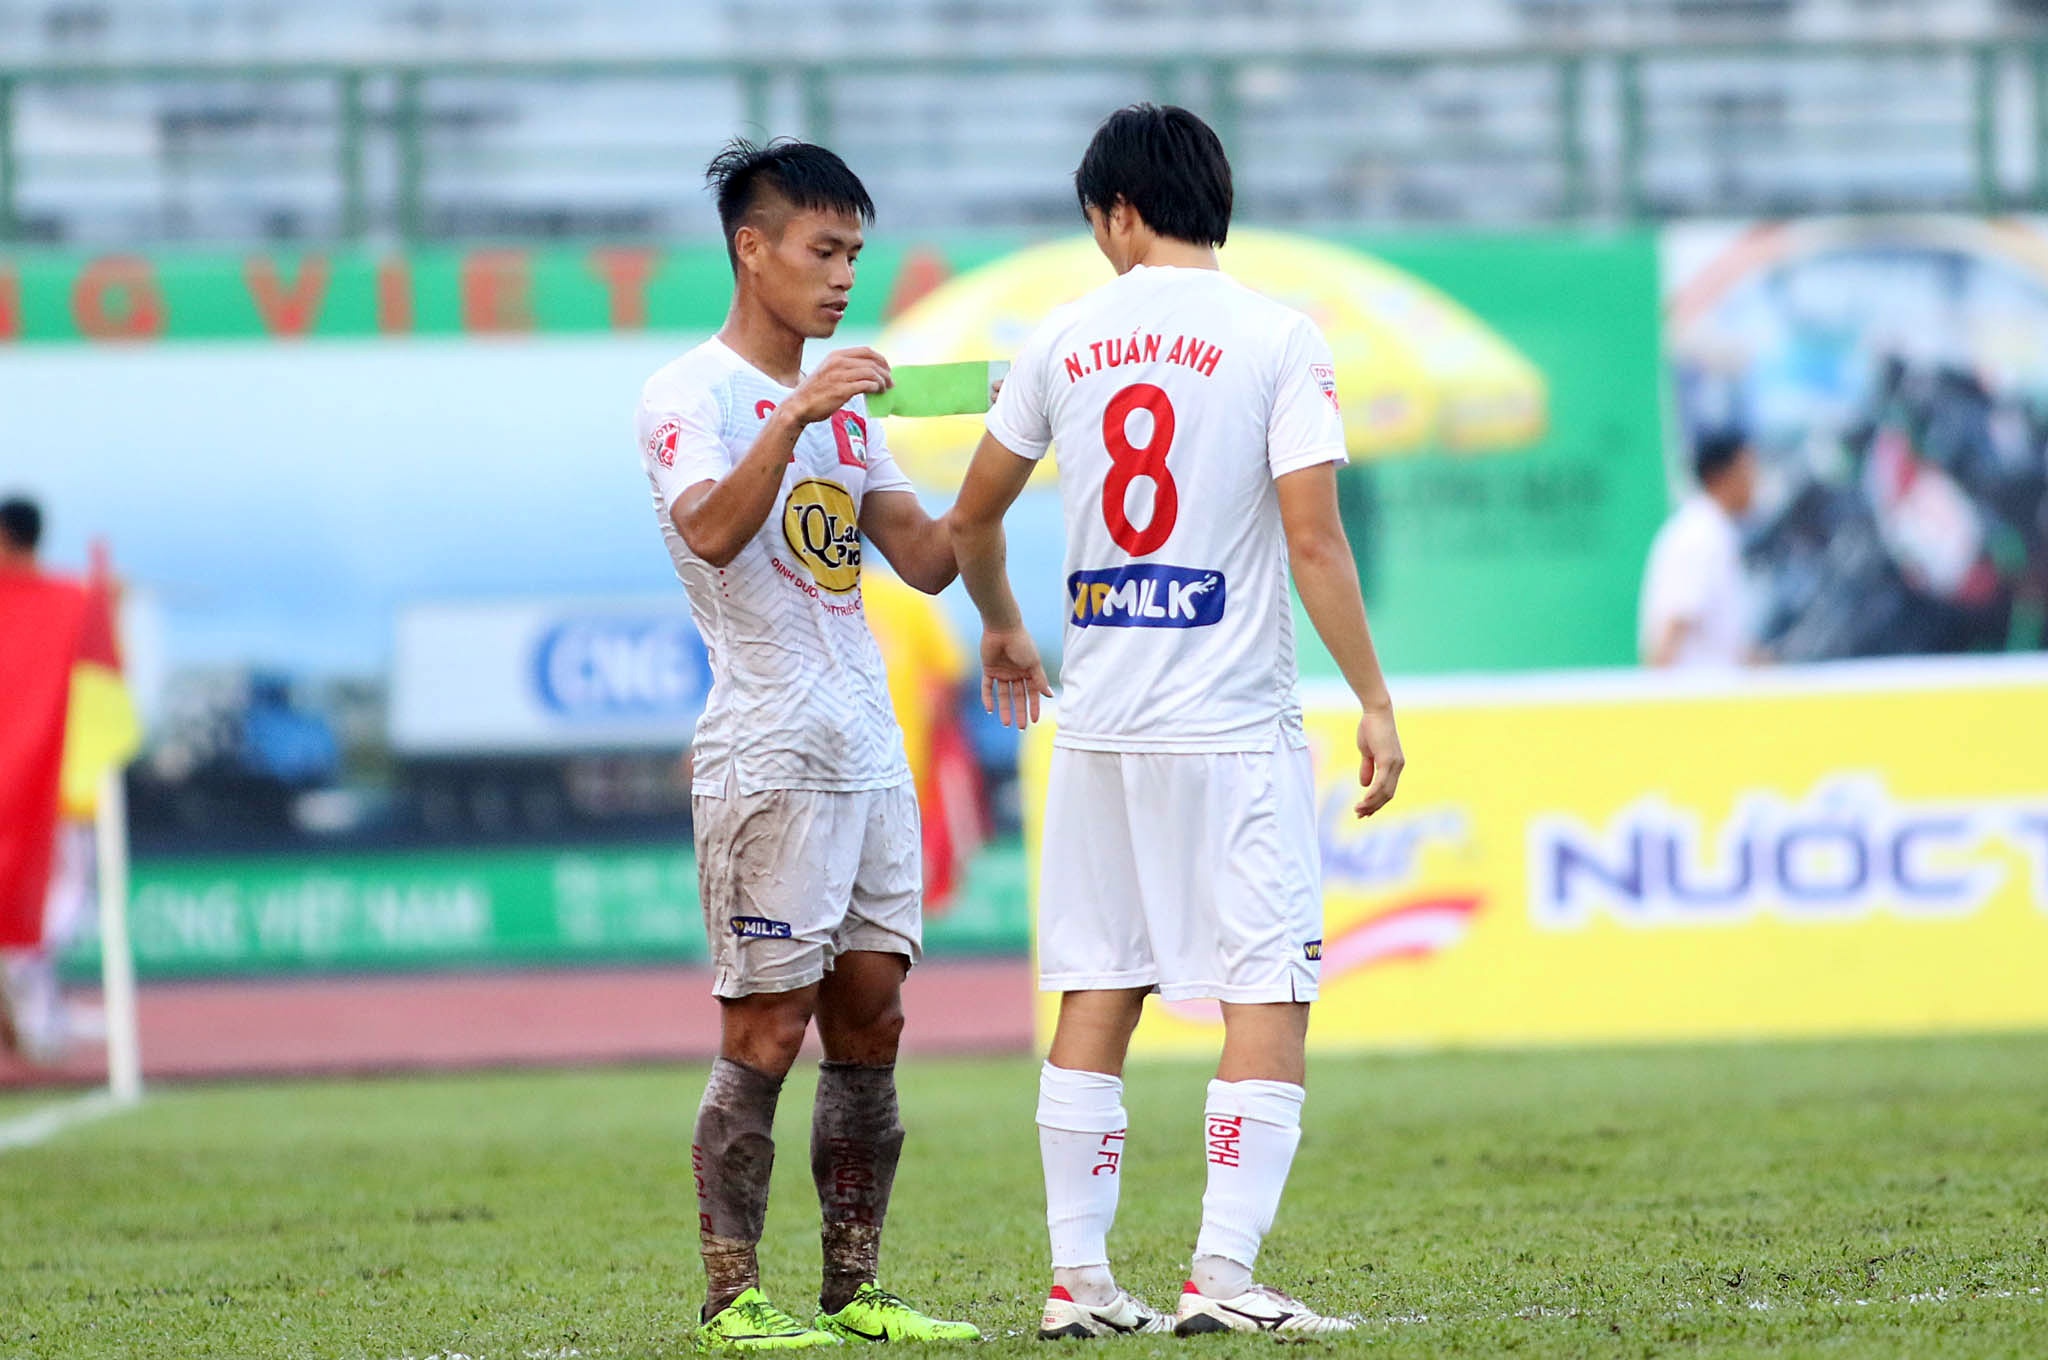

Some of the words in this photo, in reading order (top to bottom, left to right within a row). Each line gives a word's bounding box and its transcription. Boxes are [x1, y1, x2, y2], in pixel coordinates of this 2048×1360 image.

[1166, 334, 1223, 377] ANH
[1102, 383, 1179, 558] 8
[1208, 1116, 1242, 1167] HAGL
